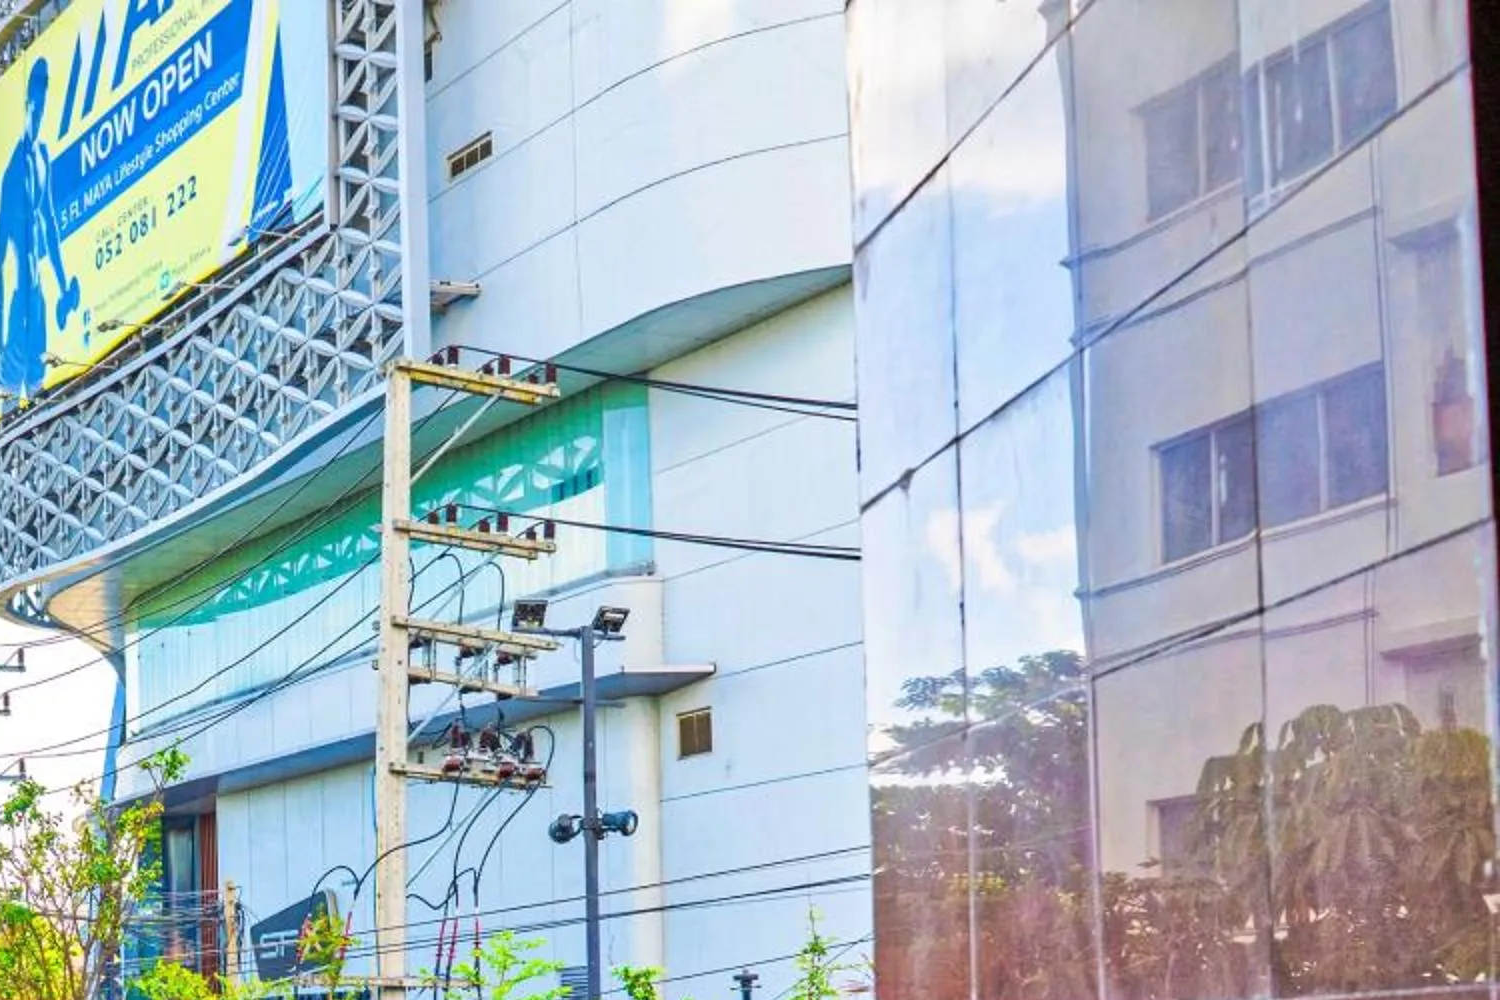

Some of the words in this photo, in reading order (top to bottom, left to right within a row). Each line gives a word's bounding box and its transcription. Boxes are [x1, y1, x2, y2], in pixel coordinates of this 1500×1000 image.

[80, 96, 137, 177] NOW
[142, 29, 213, 121] OPEN
[155, 105, 203, 151] Shopping
[203, 72, 241, 111] Center
[95, 232, 122, 270] 052
[129, 205, 157, 244] 081
[166, 175, 197, 217] 222
